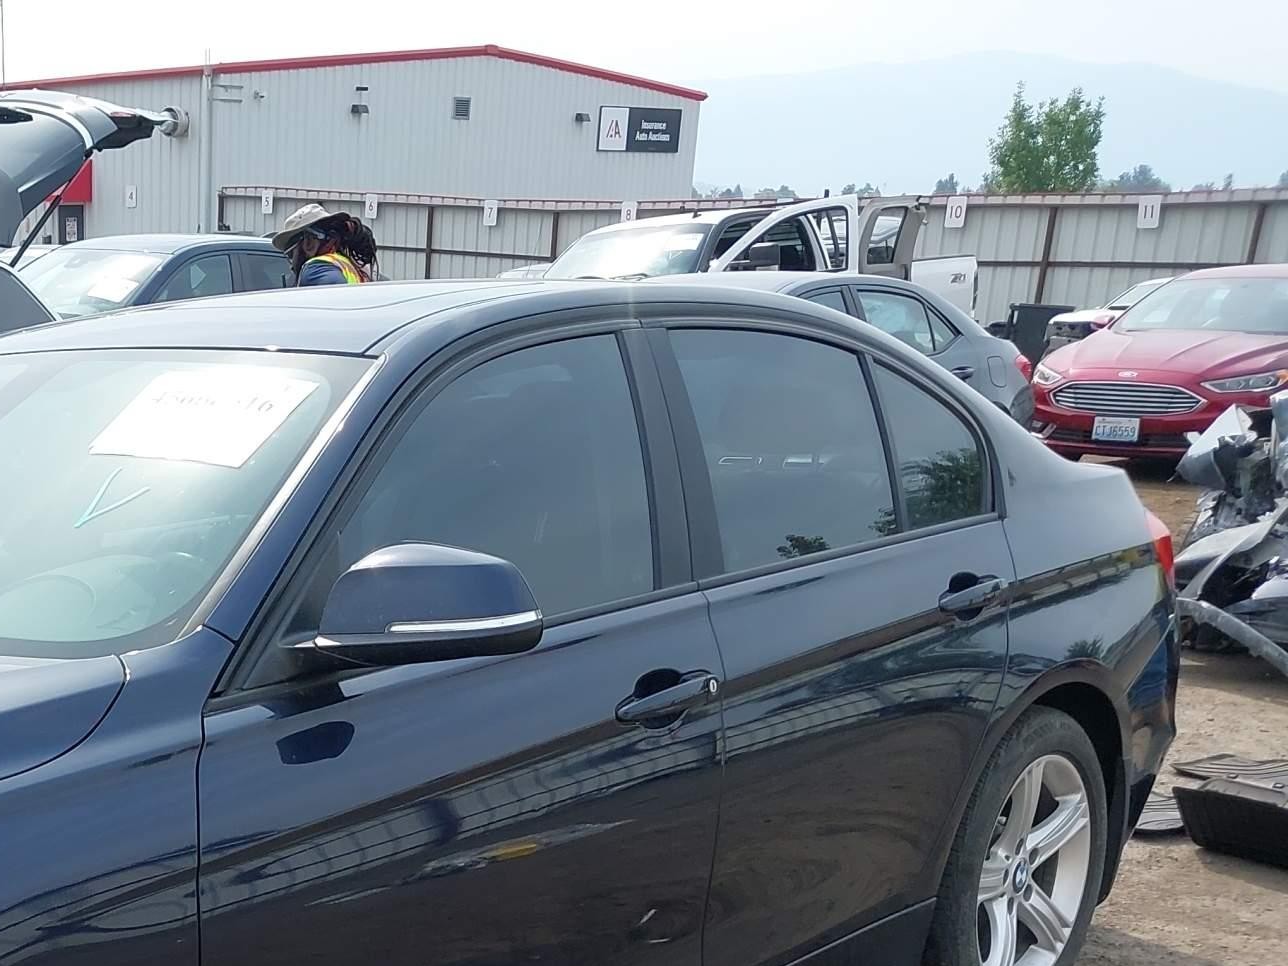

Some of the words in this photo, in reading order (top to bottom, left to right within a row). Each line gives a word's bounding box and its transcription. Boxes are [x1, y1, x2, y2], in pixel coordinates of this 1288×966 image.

[641, 119, 667, 130] Insurance
[635, 131, 648, 141] Auto
[648, 131, 670, 141] Auctions
[128, 191, 134, 201] 4
[264, 196, 270, 207] 5
[368, 200, 374, 211] 6
[487, 207, 494, 218] 7
[625, 209, 632, 221] 8
[949, 205, 963, 219] 10
[1143, 204, 1155, 219] 11
